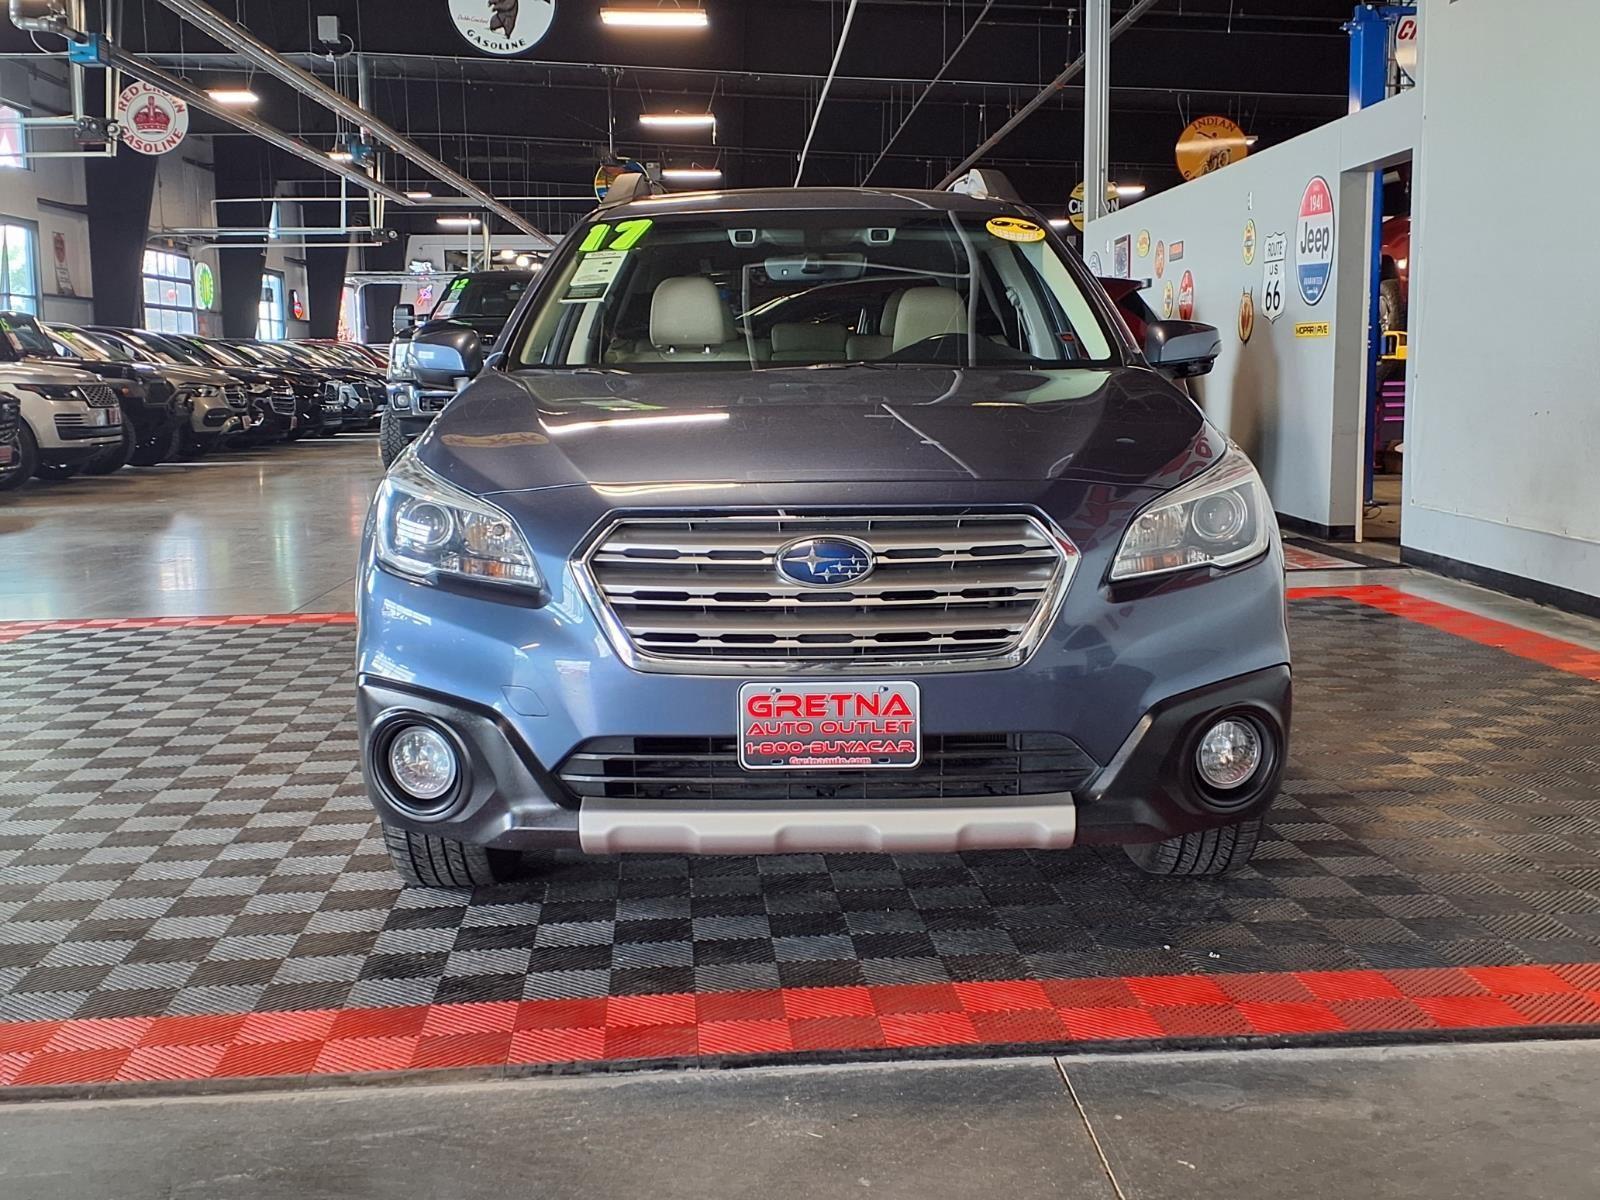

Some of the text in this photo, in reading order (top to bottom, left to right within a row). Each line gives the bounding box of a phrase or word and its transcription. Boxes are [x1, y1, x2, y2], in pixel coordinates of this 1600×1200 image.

[467, 29, 526, 50] GASOLINE
[118, 86, 139, 112] RED
[1192, 117, 1236, 132] INDIAN
[579, 219, 653, 252] 17
[1300, 221, 1330, 260] Jeep
[1267, 240, 1283, 257] ROUTE
[1269, 263, 1279, 275] US
[1265, 279, 1281, 311] 66
[747, 692, 913, 718] GRETNA
[746, 719, 915, 736] AUTO OUTLET
[745, 740, 915, 755] 1-800-BUYACAR
